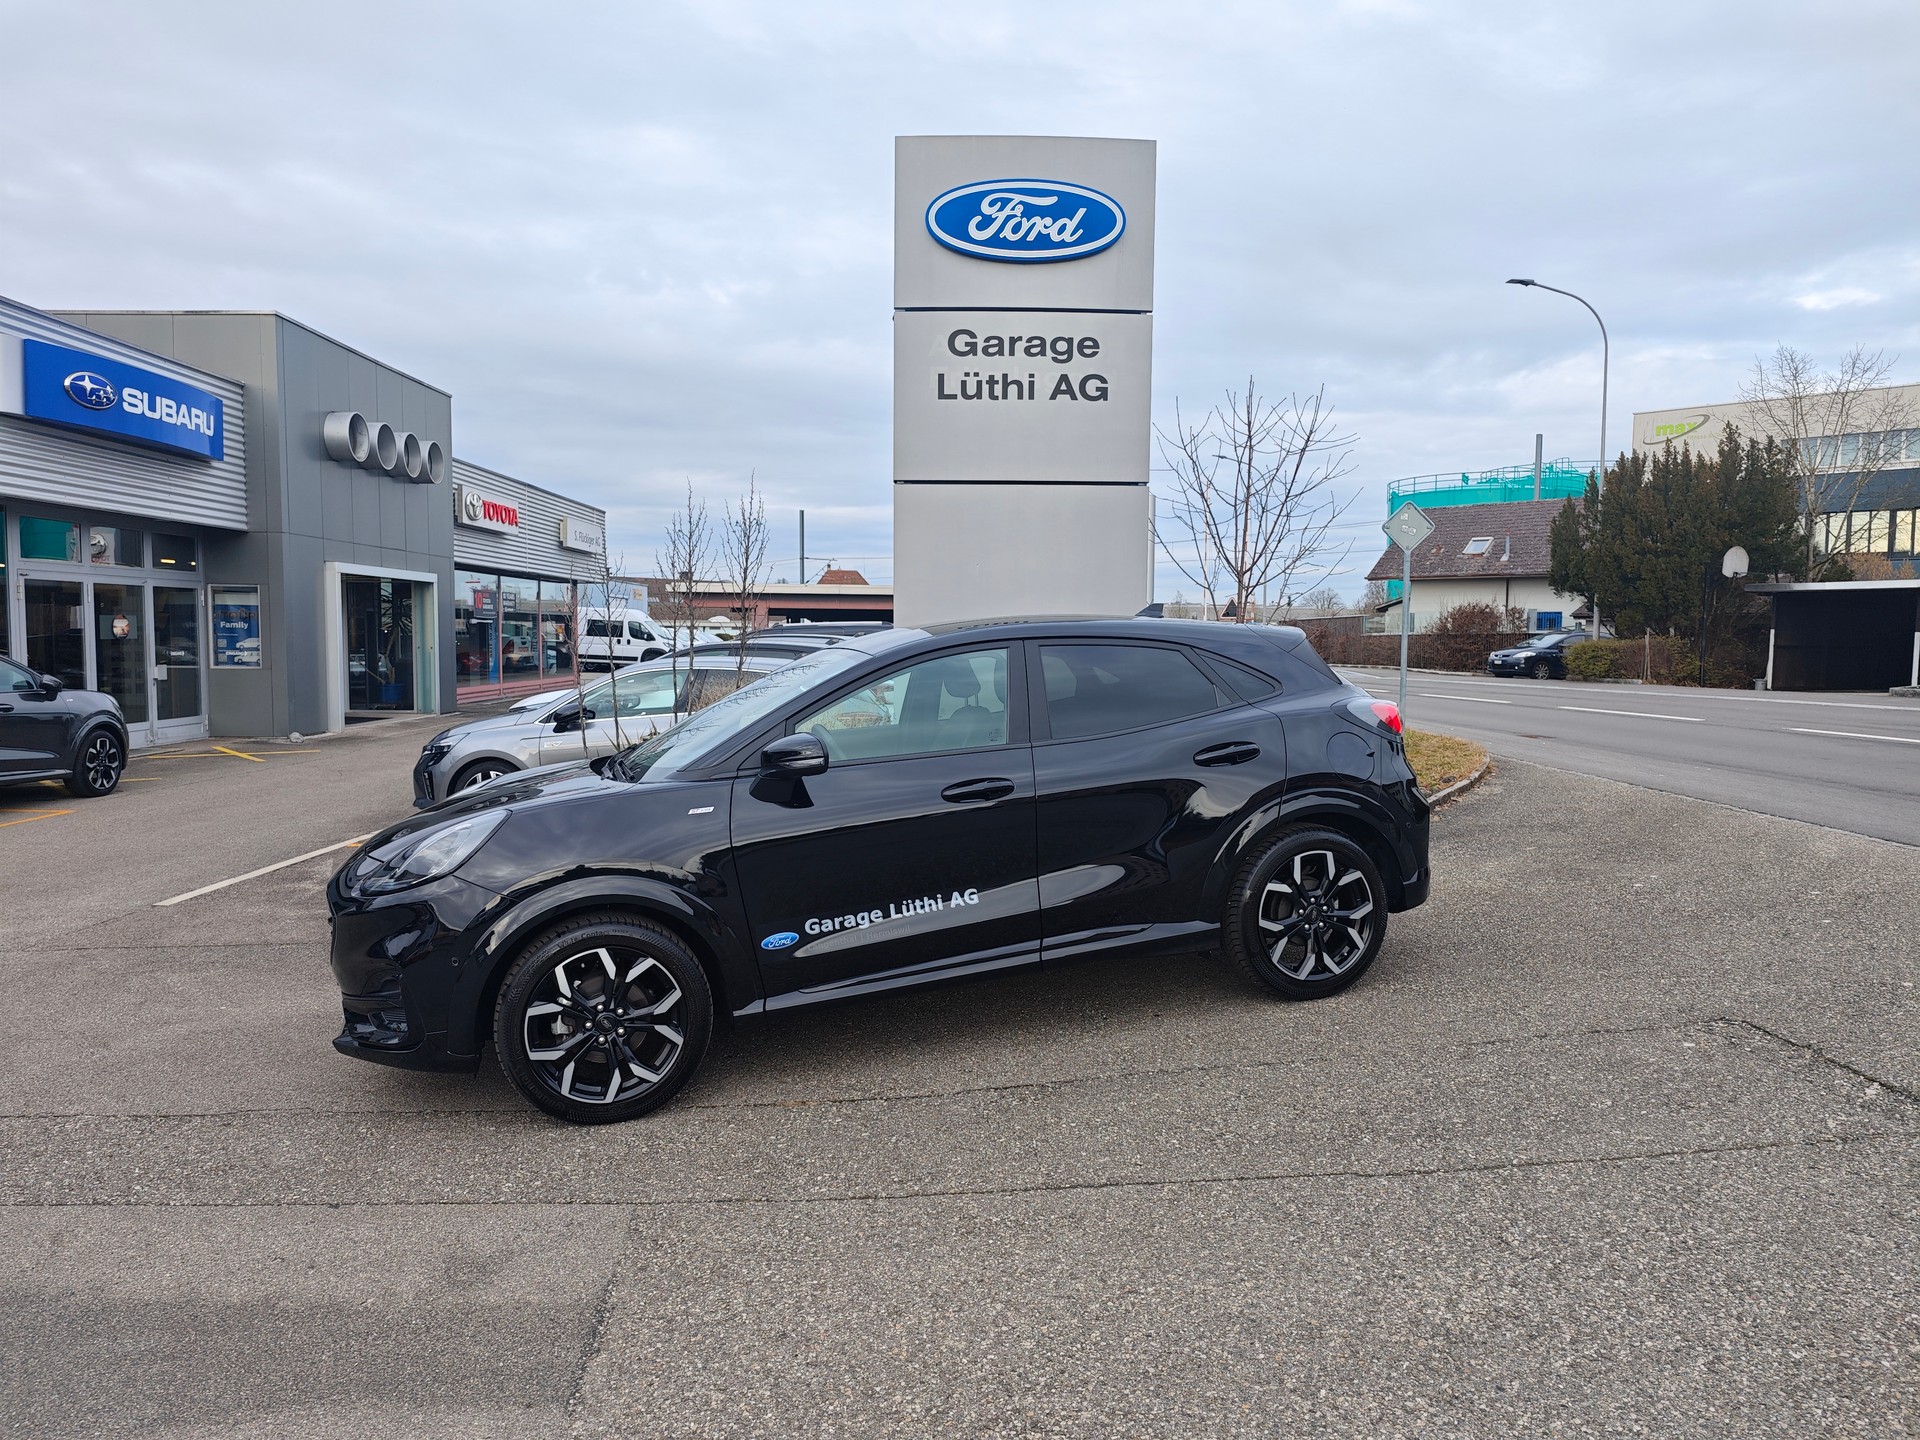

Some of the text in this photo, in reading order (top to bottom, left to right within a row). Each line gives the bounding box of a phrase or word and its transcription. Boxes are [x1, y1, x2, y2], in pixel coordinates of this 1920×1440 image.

[968, 193, 1087, 242] Ford
[947, 329, 1100, 364] Garage
[938, 372, 1109, 401] Lüthi AG
[122, 387, 214, 436] SUBARU
[482, 500, 519, 527] TOYOTA
[220, 621, 248, 629] Family
[804, 888, 979, 935] Garage Lüthi AG
[768, 934, 792, 947] Ford
[866, 925, 911, 940] Hermiswil
